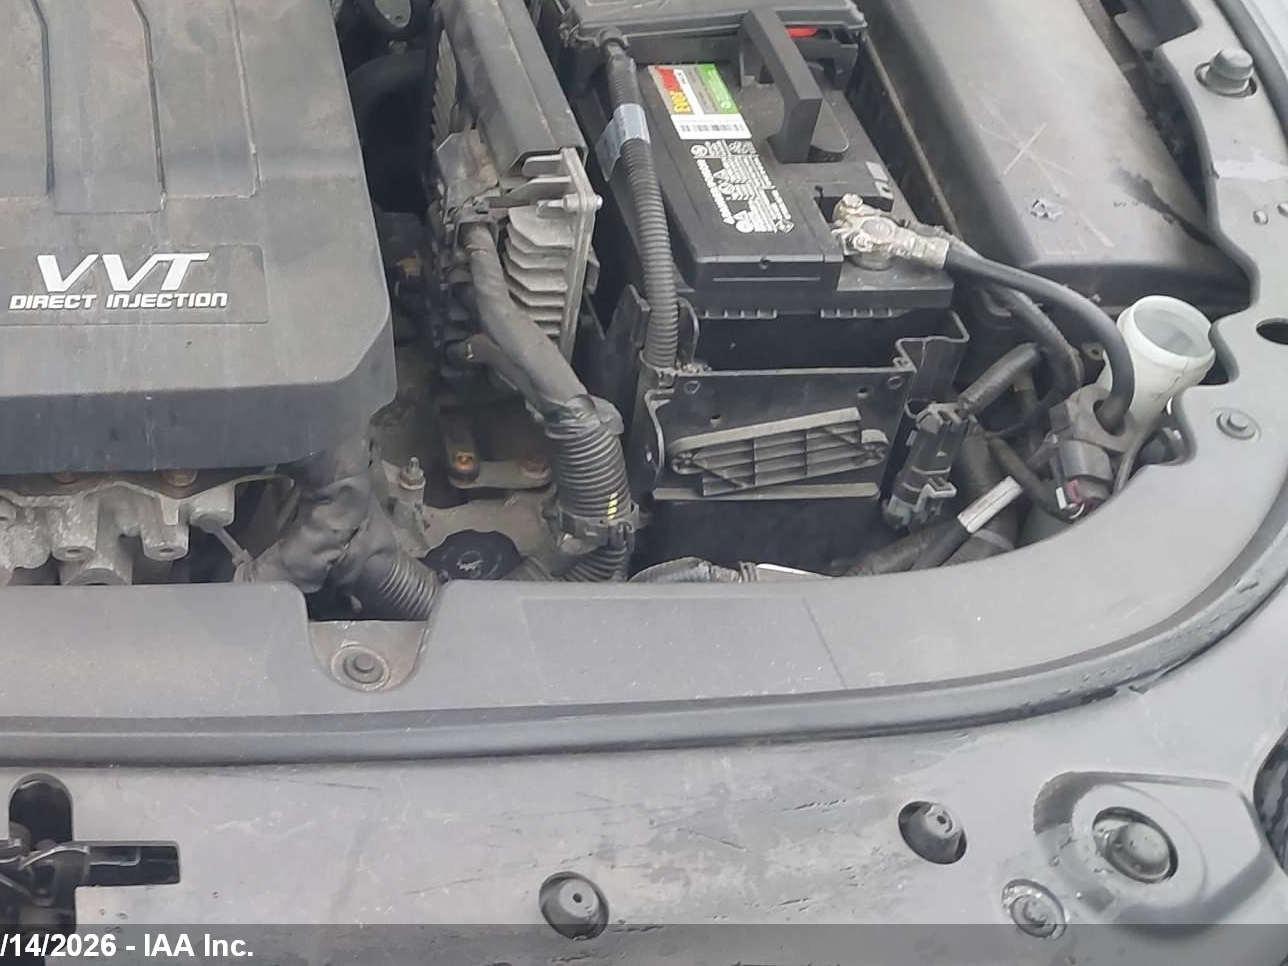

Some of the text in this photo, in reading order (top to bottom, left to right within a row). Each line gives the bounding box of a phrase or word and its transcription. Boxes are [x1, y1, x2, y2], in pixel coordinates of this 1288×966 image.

[36, 252, 210, 292] VVT
[9, 292, 229, 310] DIRECT INJECTION
